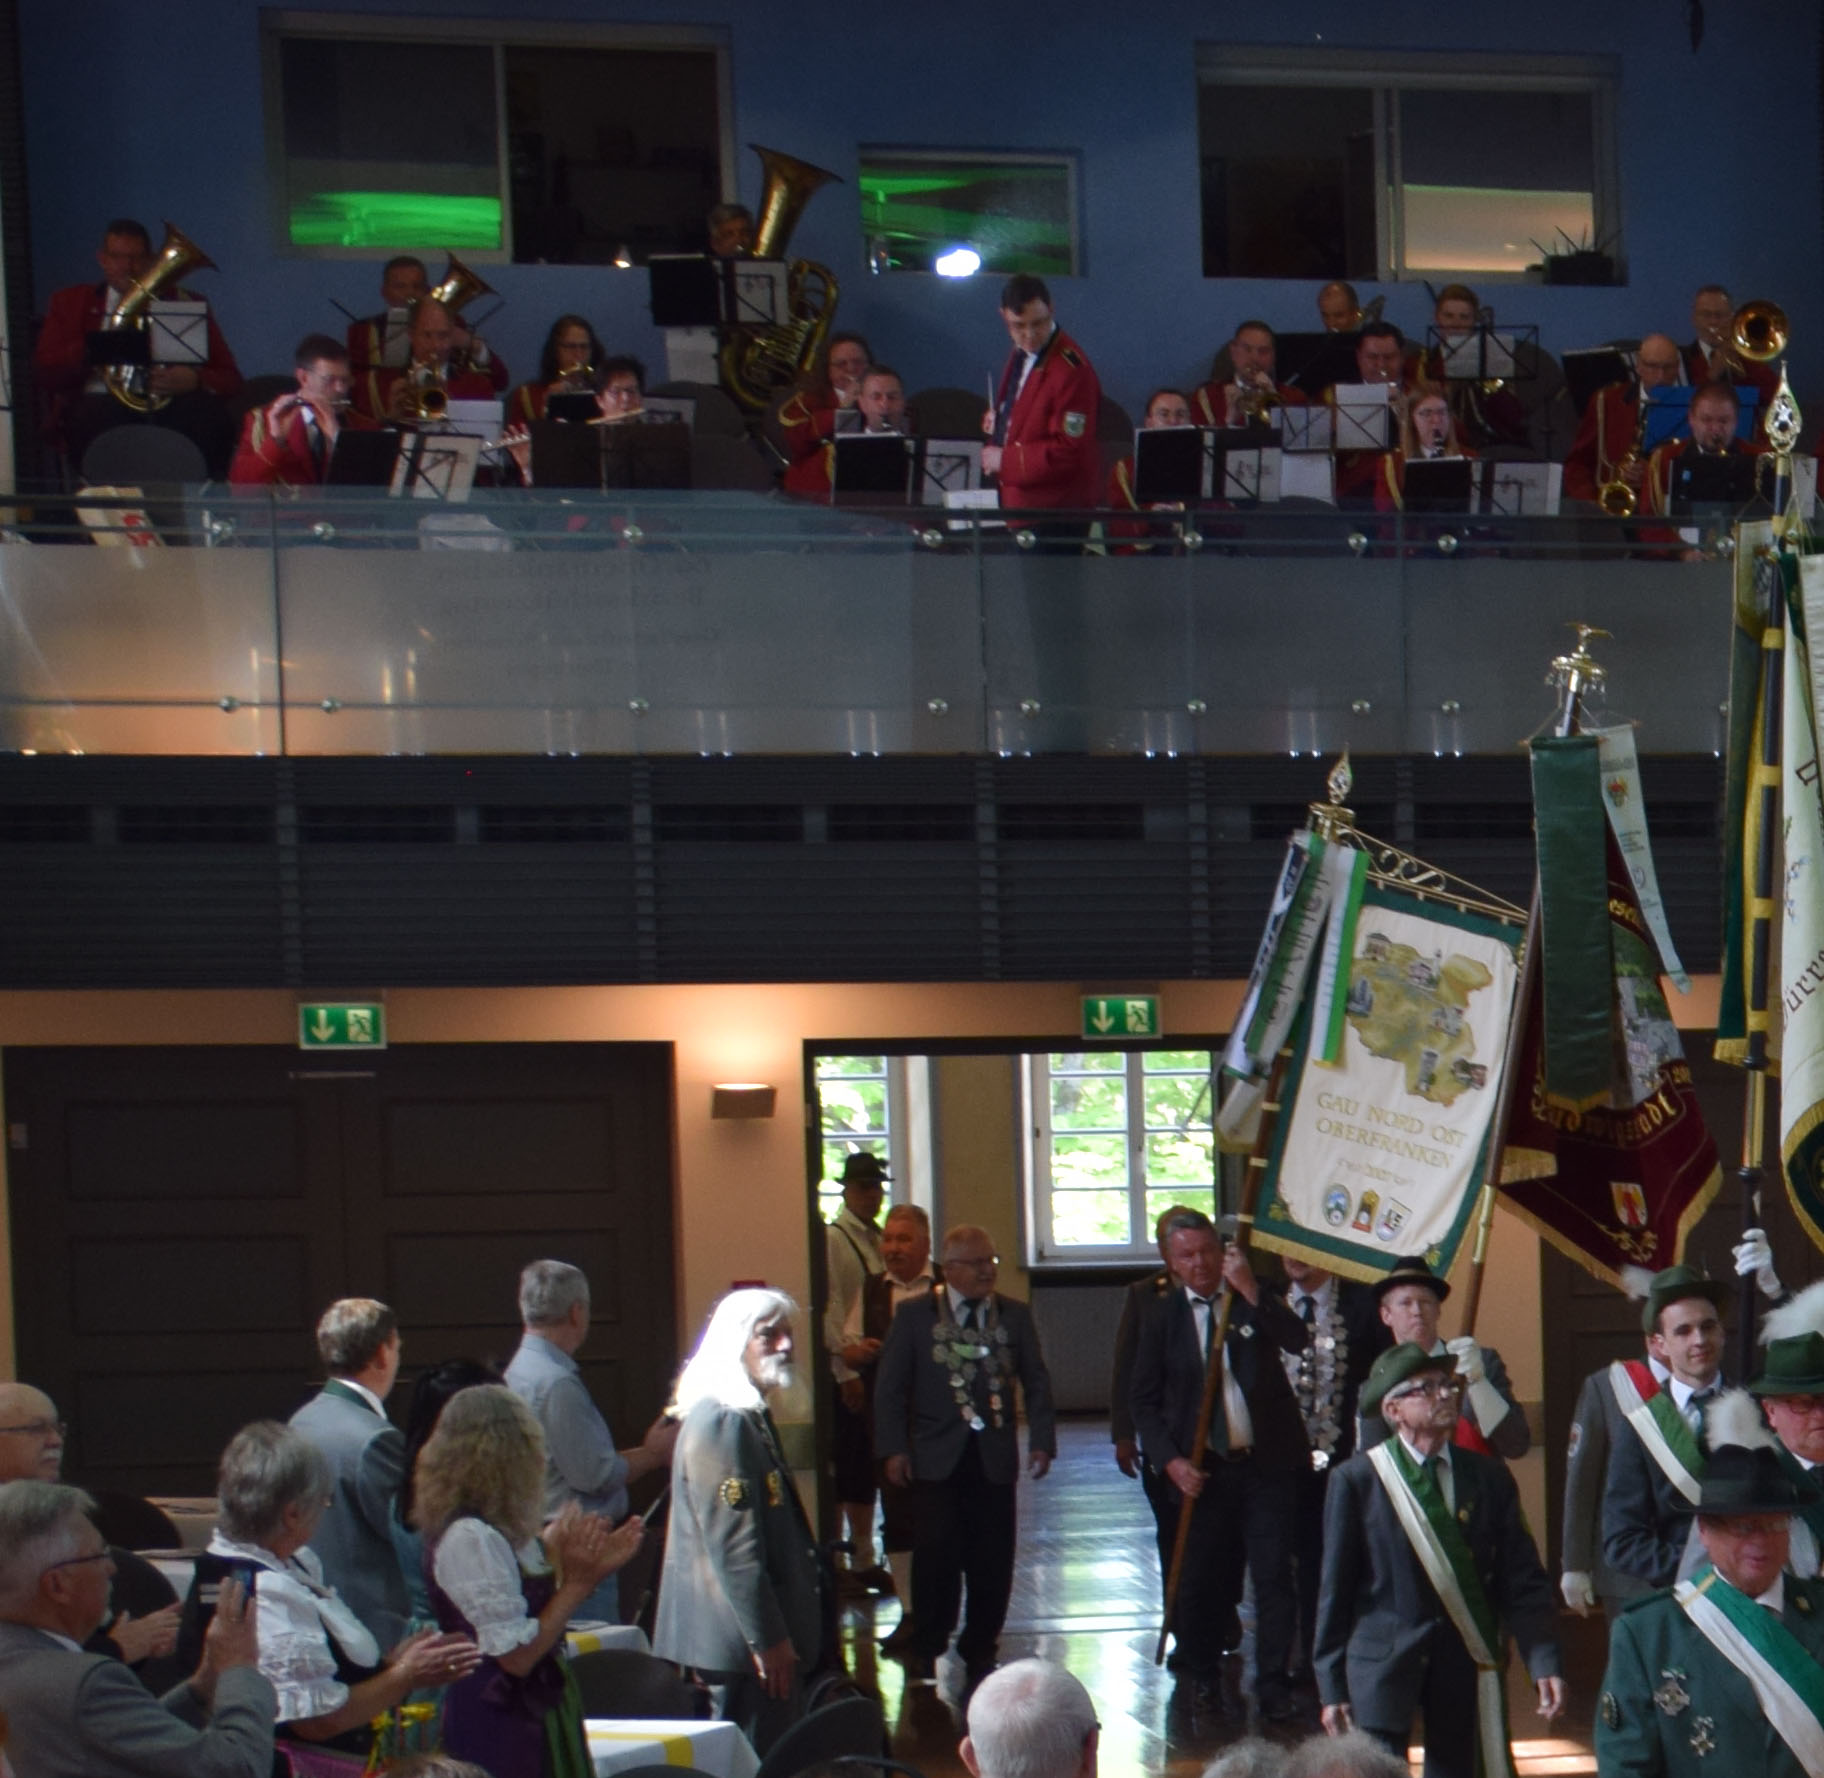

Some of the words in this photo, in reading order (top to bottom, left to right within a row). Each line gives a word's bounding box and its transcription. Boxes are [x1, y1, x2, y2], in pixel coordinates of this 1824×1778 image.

[1315, 1117, 1455, 1169] OBERFRANKEN
[1316, 1091, 1360, 1117] GAU
[1367, 1103, 1426, 1135] NORD
[1430, 1124, 1469, 1149] OST
